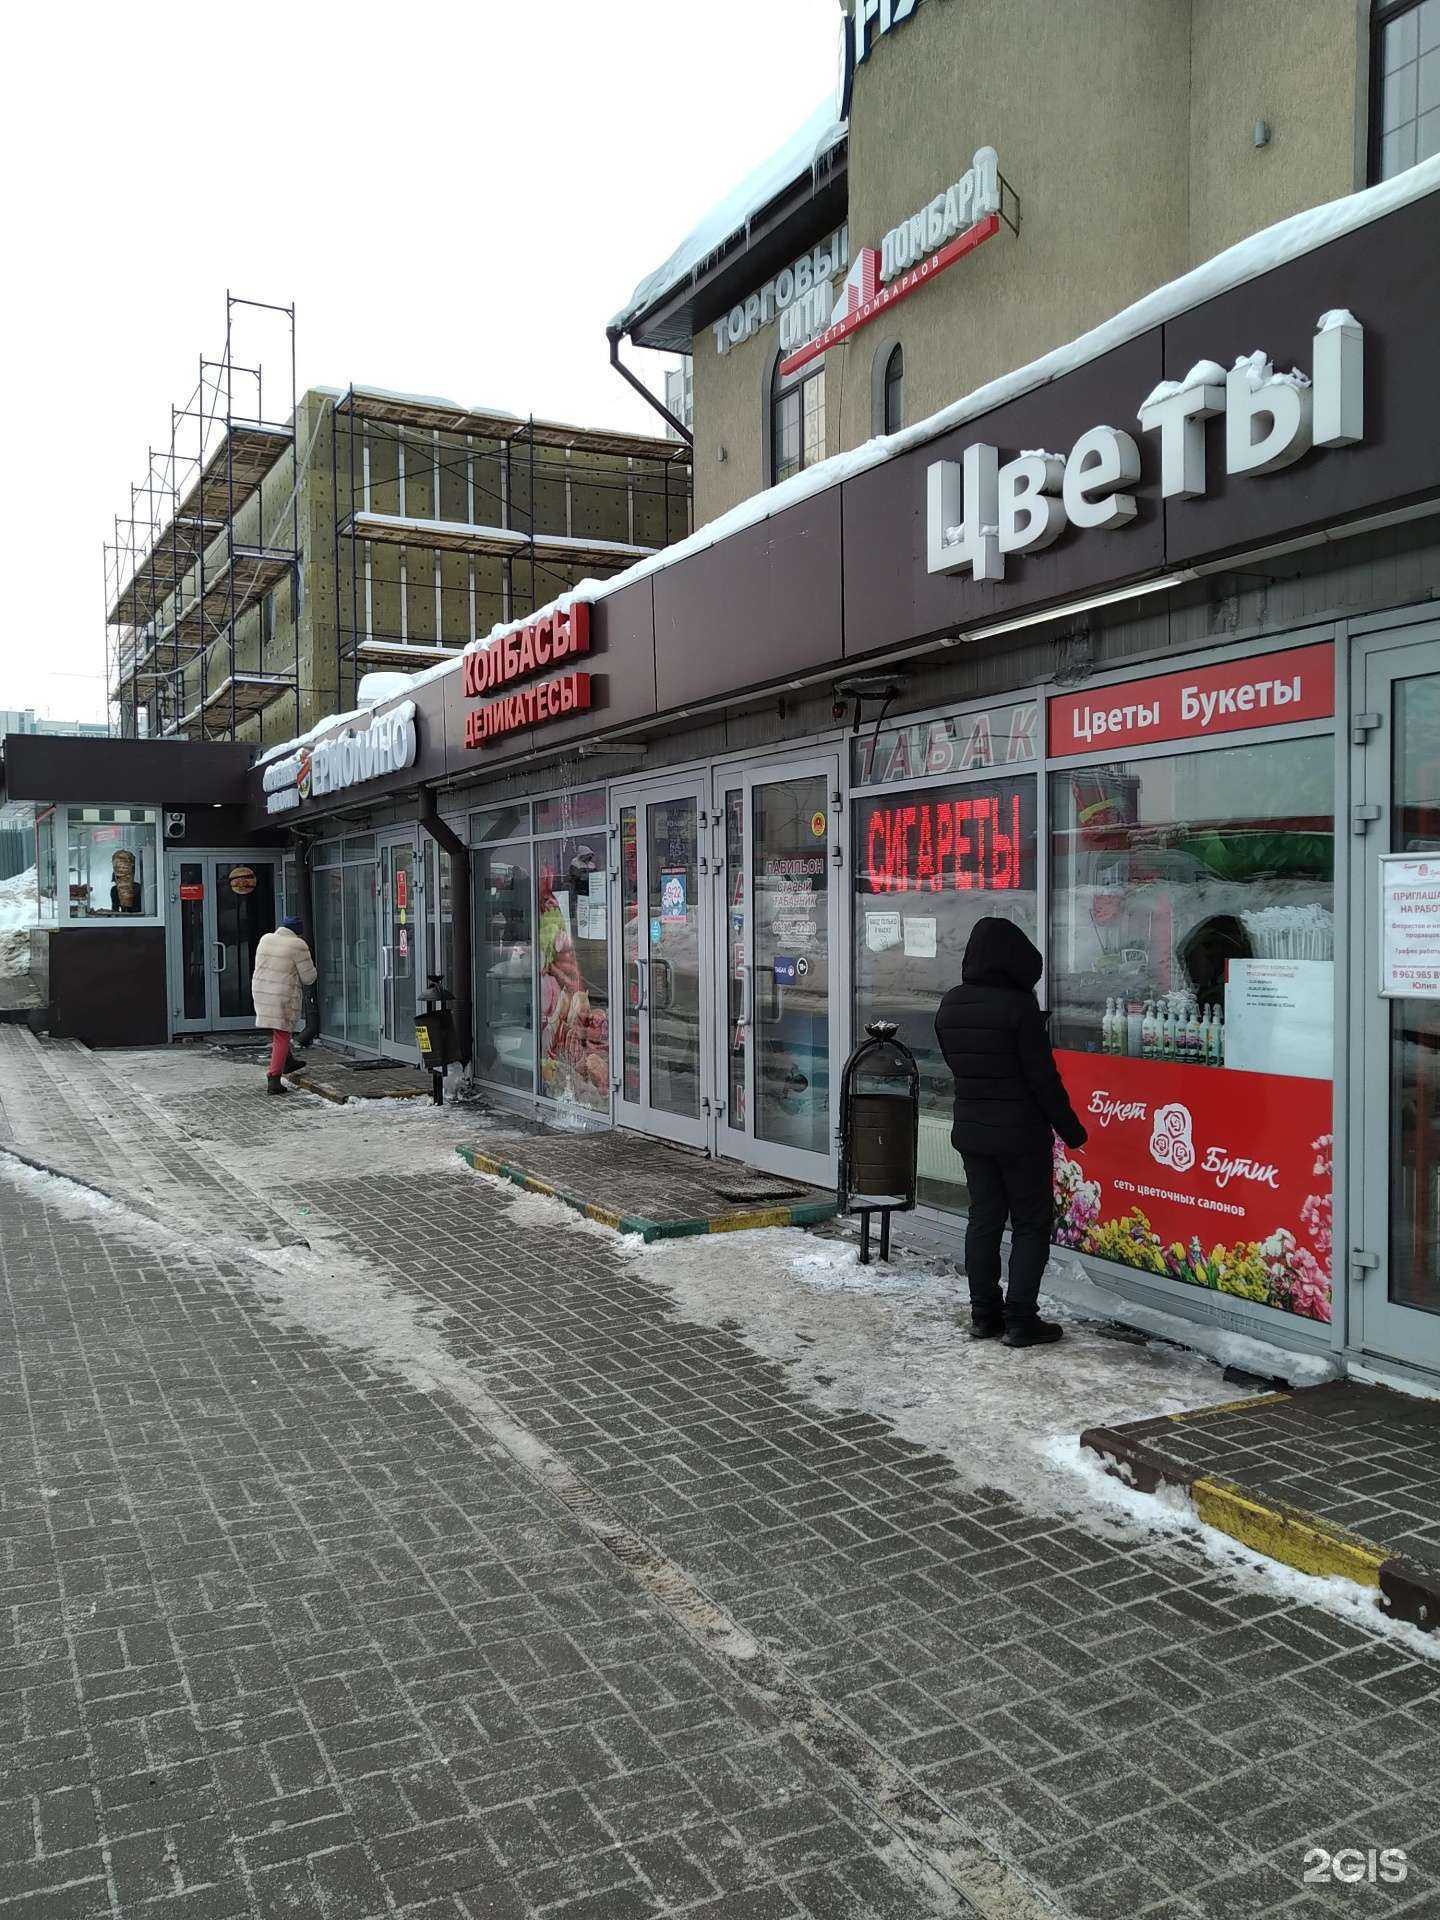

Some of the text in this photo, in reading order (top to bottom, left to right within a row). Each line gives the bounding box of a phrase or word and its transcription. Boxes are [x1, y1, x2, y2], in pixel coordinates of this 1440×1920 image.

[780, 156, 999, 350] СИТИ ЛОМБАРД
[815, 254, 939, 349] СЕТЬ ЛОМБАРДОВ
[926, 320, 1364, 582] Цветы
[464, 603, 590, 697] КОЛБАСЫ
[464, 672, 590, 749] ДЕЛИКАТЕСЫ
[859, 706, 1036, 785] ТАБАК
[1072, 676, 1301, 743] Цветы Букеты
[766, 858, 824, 875] ПАВИЛЬОН
[867, 793, 1020, 893] СИГАРЕТЫ
[1400, 904, 1413, 913] НА
[1412, 981, 1437, 990] Юлия
[1087, 1090, 1147, 1127] Букет
[1113, 1178, 1246, 1217] сеть цветочных салонов
[1201, 1146, 1280, 1189] Бутик
